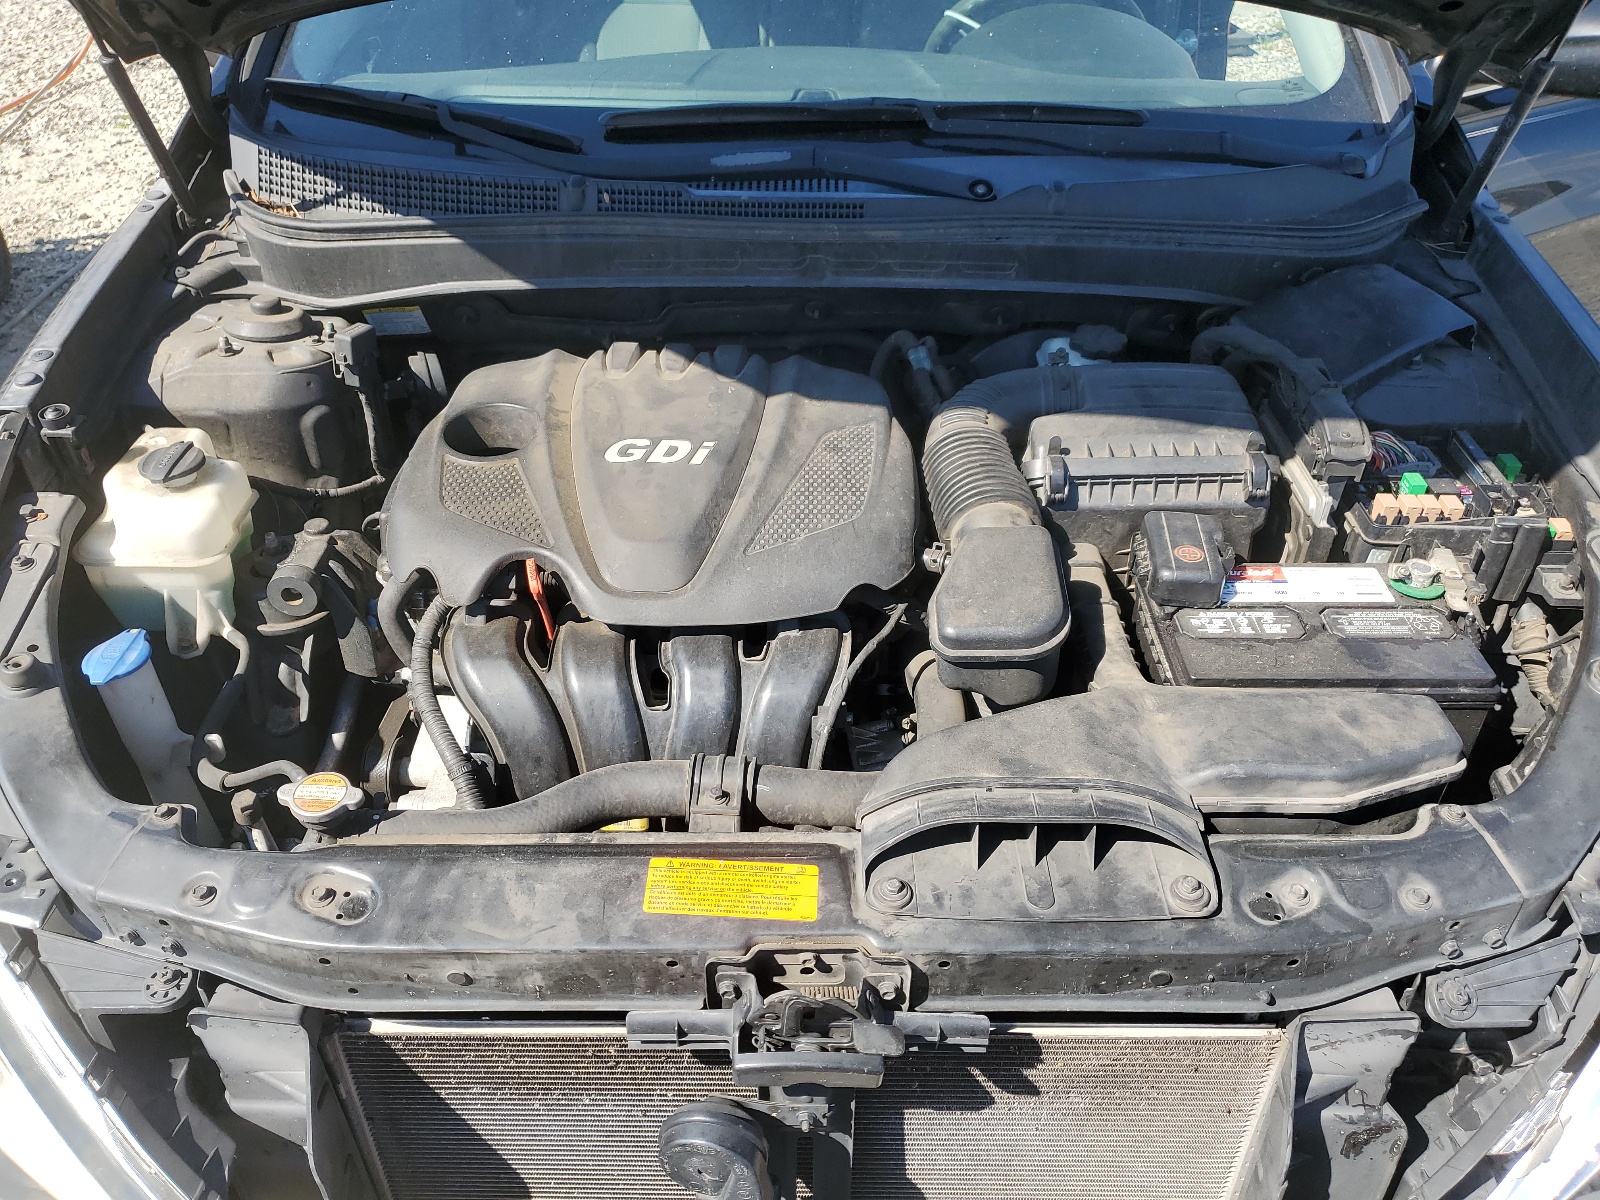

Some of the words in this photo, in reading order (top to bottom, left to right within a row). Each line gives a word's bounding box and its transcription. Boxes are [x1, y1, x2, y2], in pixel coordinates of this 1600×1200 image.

[604, 438, 718, 465] GDi
[1227, 568, 1274, 576] uralast
[723, 864, 784, 872] AVERTISSEMENT
